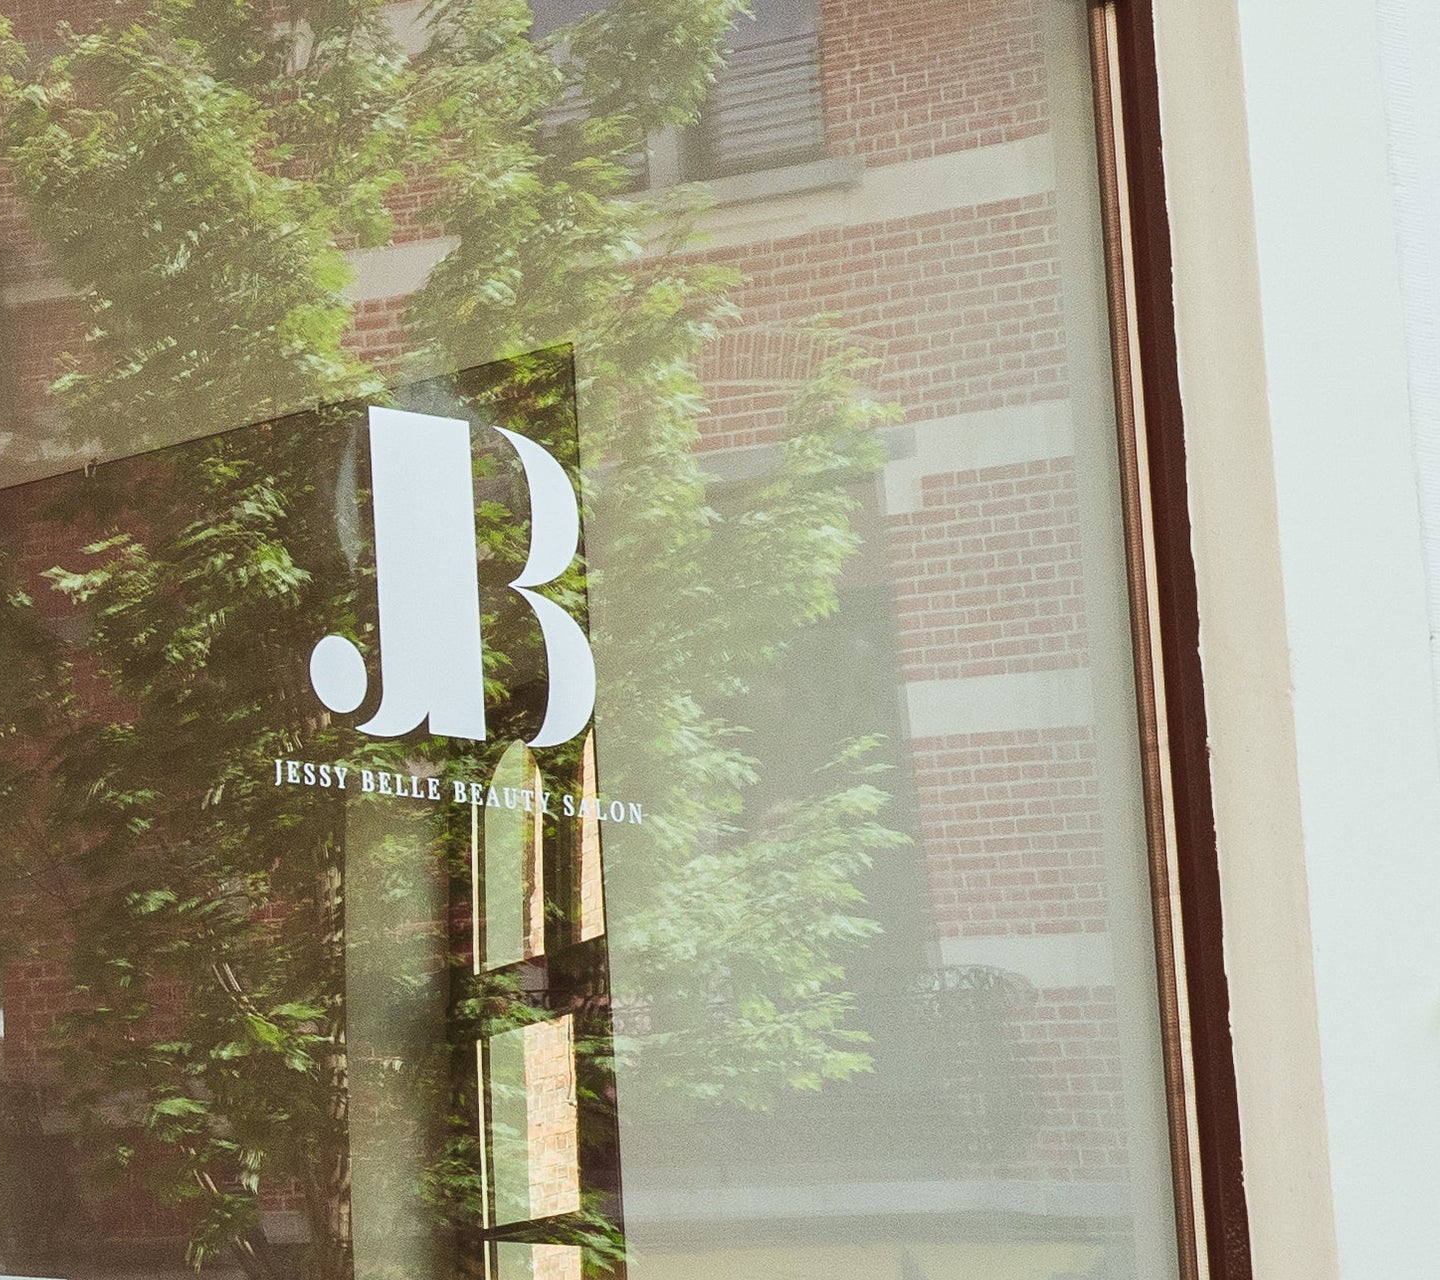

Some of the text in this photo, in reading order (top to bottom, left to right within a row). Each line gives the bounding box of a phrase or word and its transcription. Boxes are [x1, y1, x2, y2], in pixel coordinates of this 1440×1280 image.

[309, 405, 597, 749] JB
[274, 758, 644, 825] JESSY BELLE BEAUTY SALON
